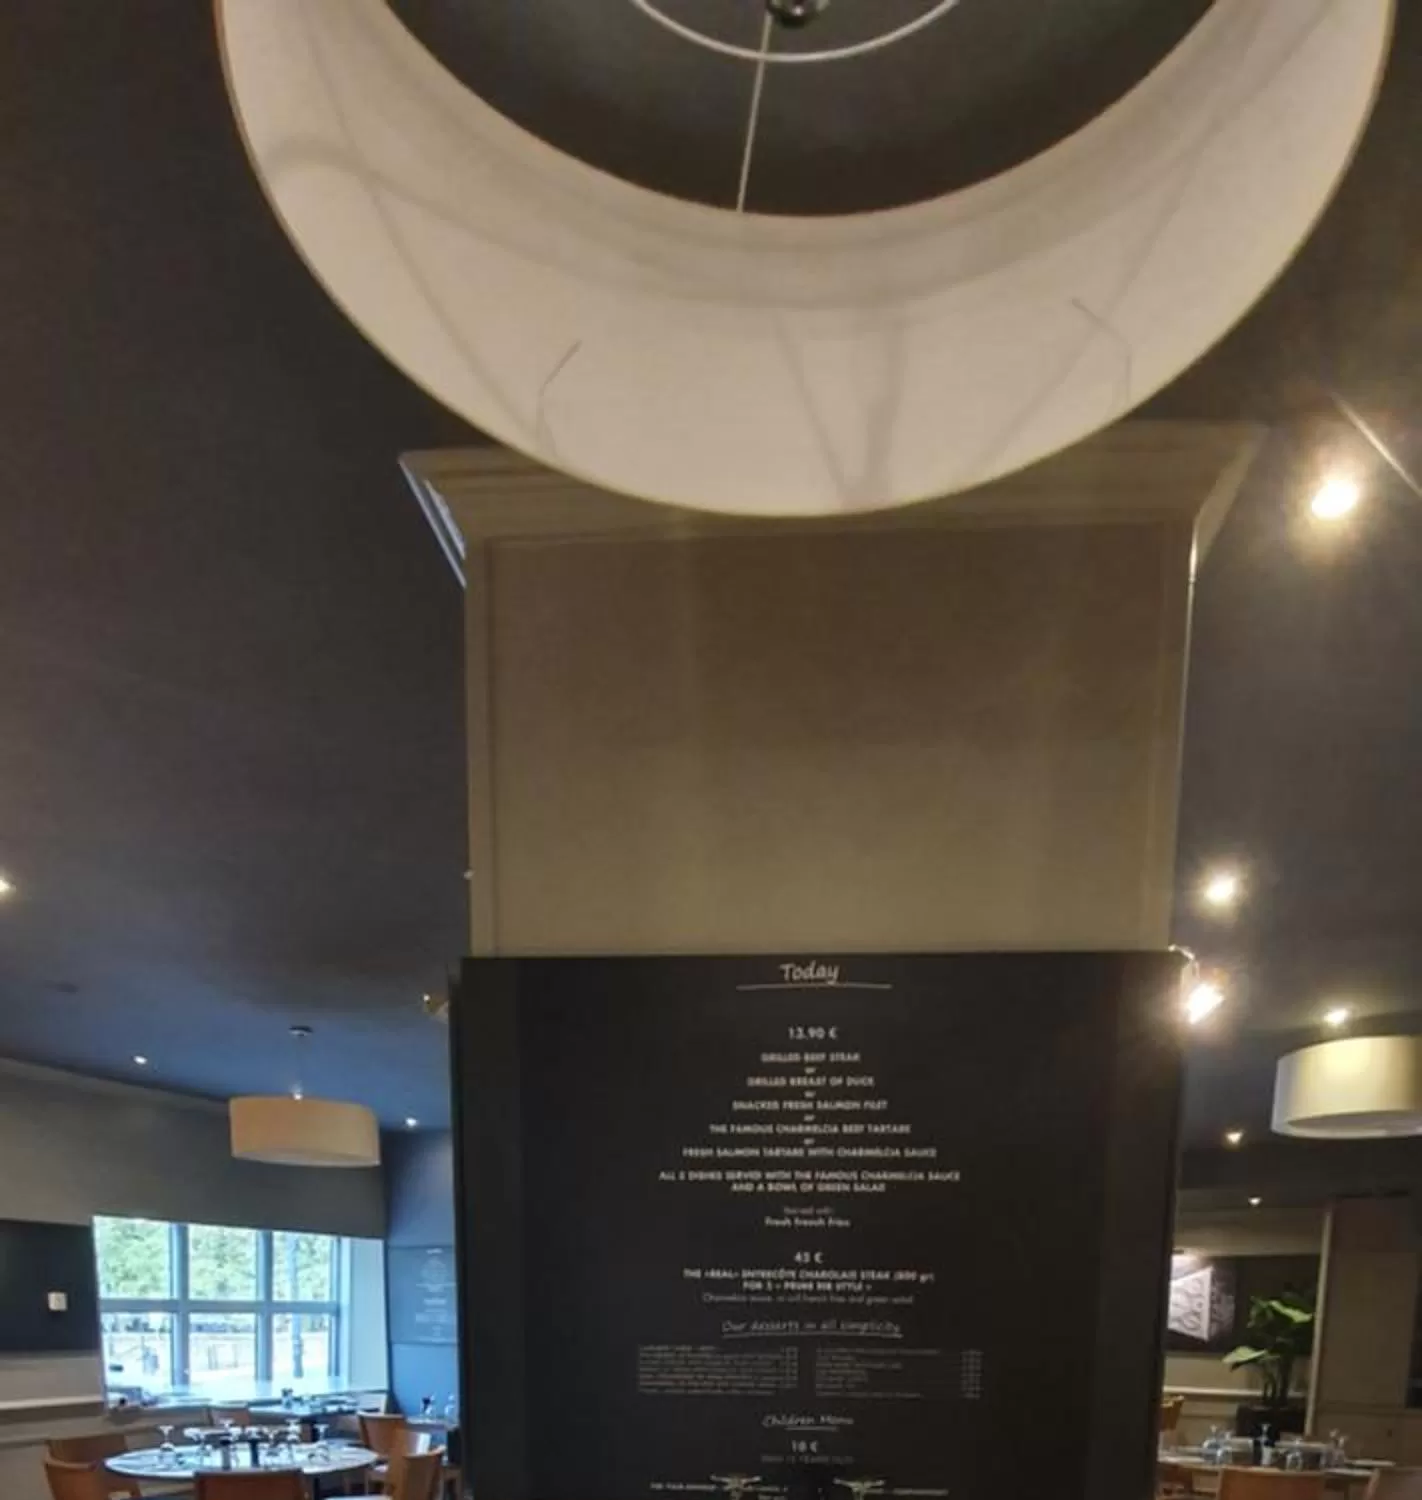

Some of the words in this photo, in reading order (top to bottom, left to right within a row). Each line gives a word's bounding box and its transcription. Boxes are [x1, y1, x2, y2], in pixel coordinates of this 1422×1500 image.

[779, 961, 840, 985] Today
[828, 1026, 838, 1040] €
[760, 1052, 802, 1063] GRILLED
[829, 1052, 861, 1062] STEAK
[746, 1076, 788, 1087] GRILLED
[829, 1076, 844, 1087] OF
[845, 1076, 875, 1087] DUCK
[782, 1100, 814, 1110] FRESH
[816, 1100, 862, 1110] SALMON
[709, 1123, 728, 1134] THE
[729, 1124, 774, 1134] FAMOUS
[841, 1123, 865, 1134] BEEF
[867, 1123, 911, 1134] TARTARE
[682, 1147, 714, 1157] FRESH
[715, 1147, 761, 1157] SALMON
[807, 1147, 835, 1157] WITH
[903, 1147, 937, 1158] SAUCE
[658, 1171, 676, 1181] ALL
[725, 1170, 763, 1181] SERVED
[764, 1170, 792, 1180] WITH
[793, 1170, 813, 1180] THE
[814, 1171, 859, 1181] FAMOUS
[927, 1171, 961, 1181] SAUCE
[730, 1182, 755, 1192] AND
[766, 1182, 798, 1192] BOWL
[799, 1182, 814, 1193] OF
[816, 1182, 851, 1192] GREEN
[852, 1182, 886, 1193] SALAD
[683, 1268, 702, 1279] THE
[859, 1270, 891, 1281] STEAK
[742, 1280, 764, 1290] FOR
[721, 1320, 746, 1333] Our
[761, 1413, 816, 1429] Children
